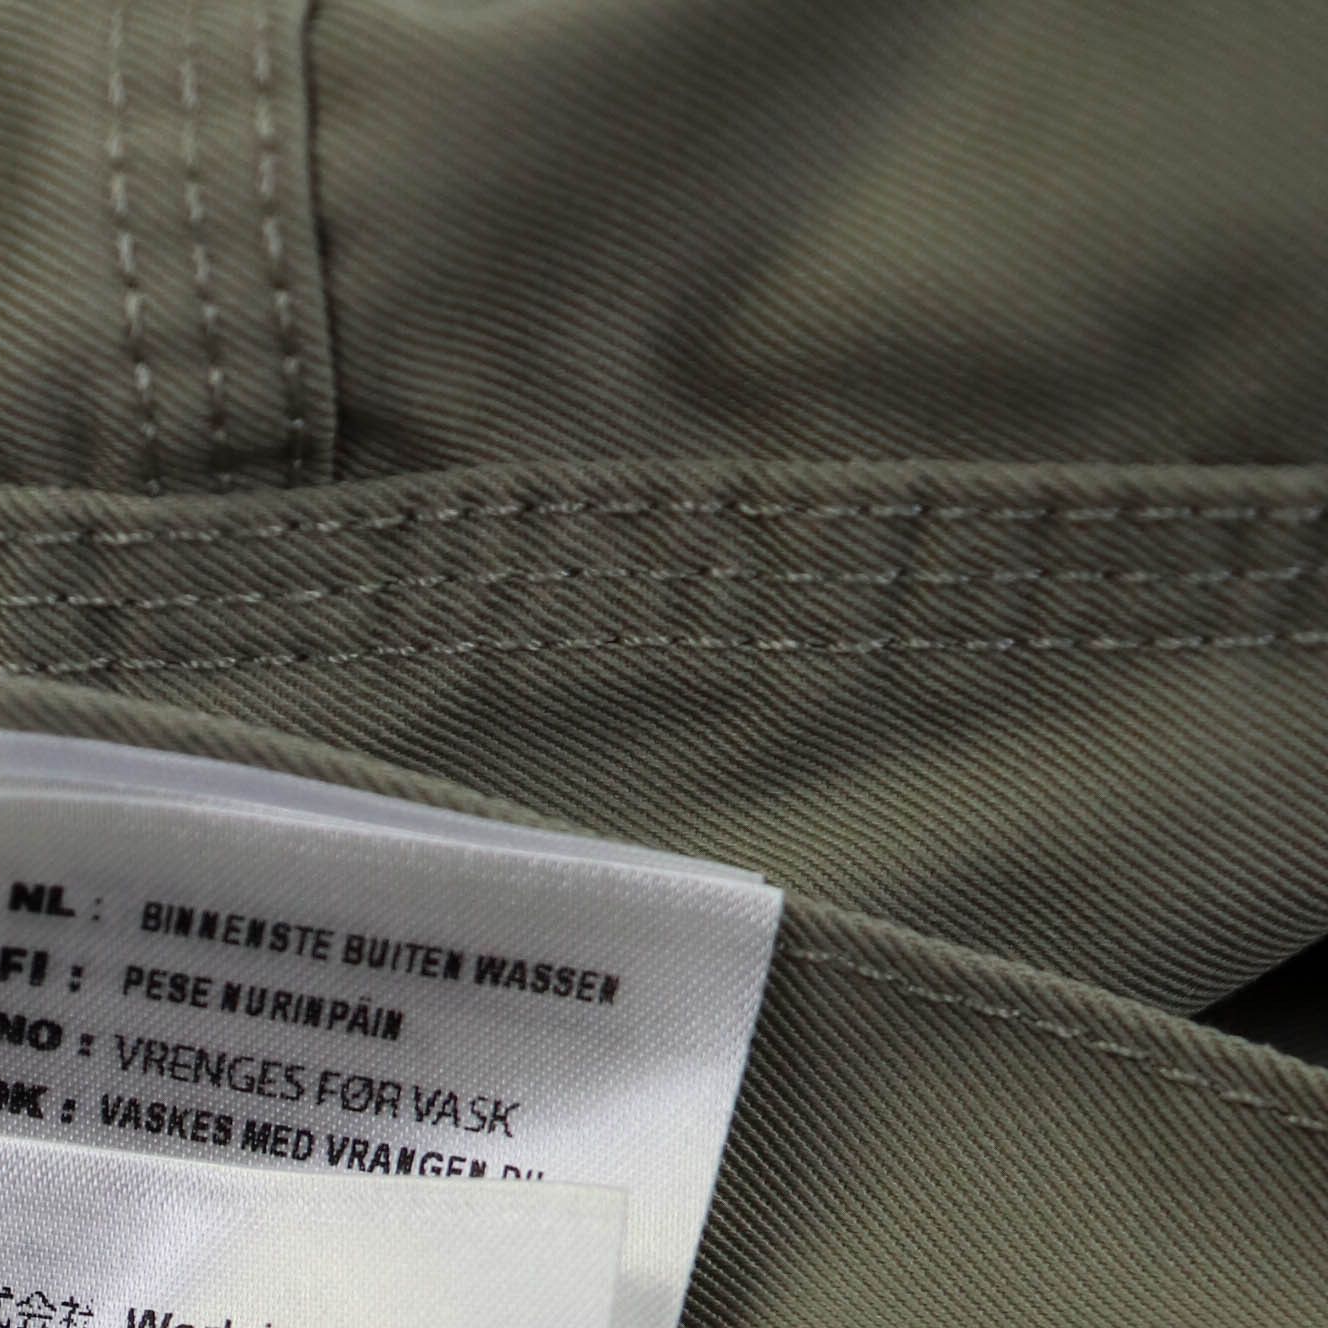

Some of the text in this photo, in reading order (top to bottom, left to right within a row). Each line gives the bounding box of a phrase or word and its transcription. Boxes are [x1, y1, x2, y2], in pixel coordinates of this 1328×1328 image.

[123, 964, 214, 1009] PESE
[141, 901, 334, 961] BINNENSTE
[342, 933, 464, 981] BUITEN
[474, 954, 620, 1005] WASSEN
[100, 1093, 233, 1147] VASKES
[241, 1119, 314, 1161] MED
[114, 1034, 305, 1102] VRENGES
[315, 1070, 402, 1119] FØR
[413, 1085, 521, 1138] VASK
